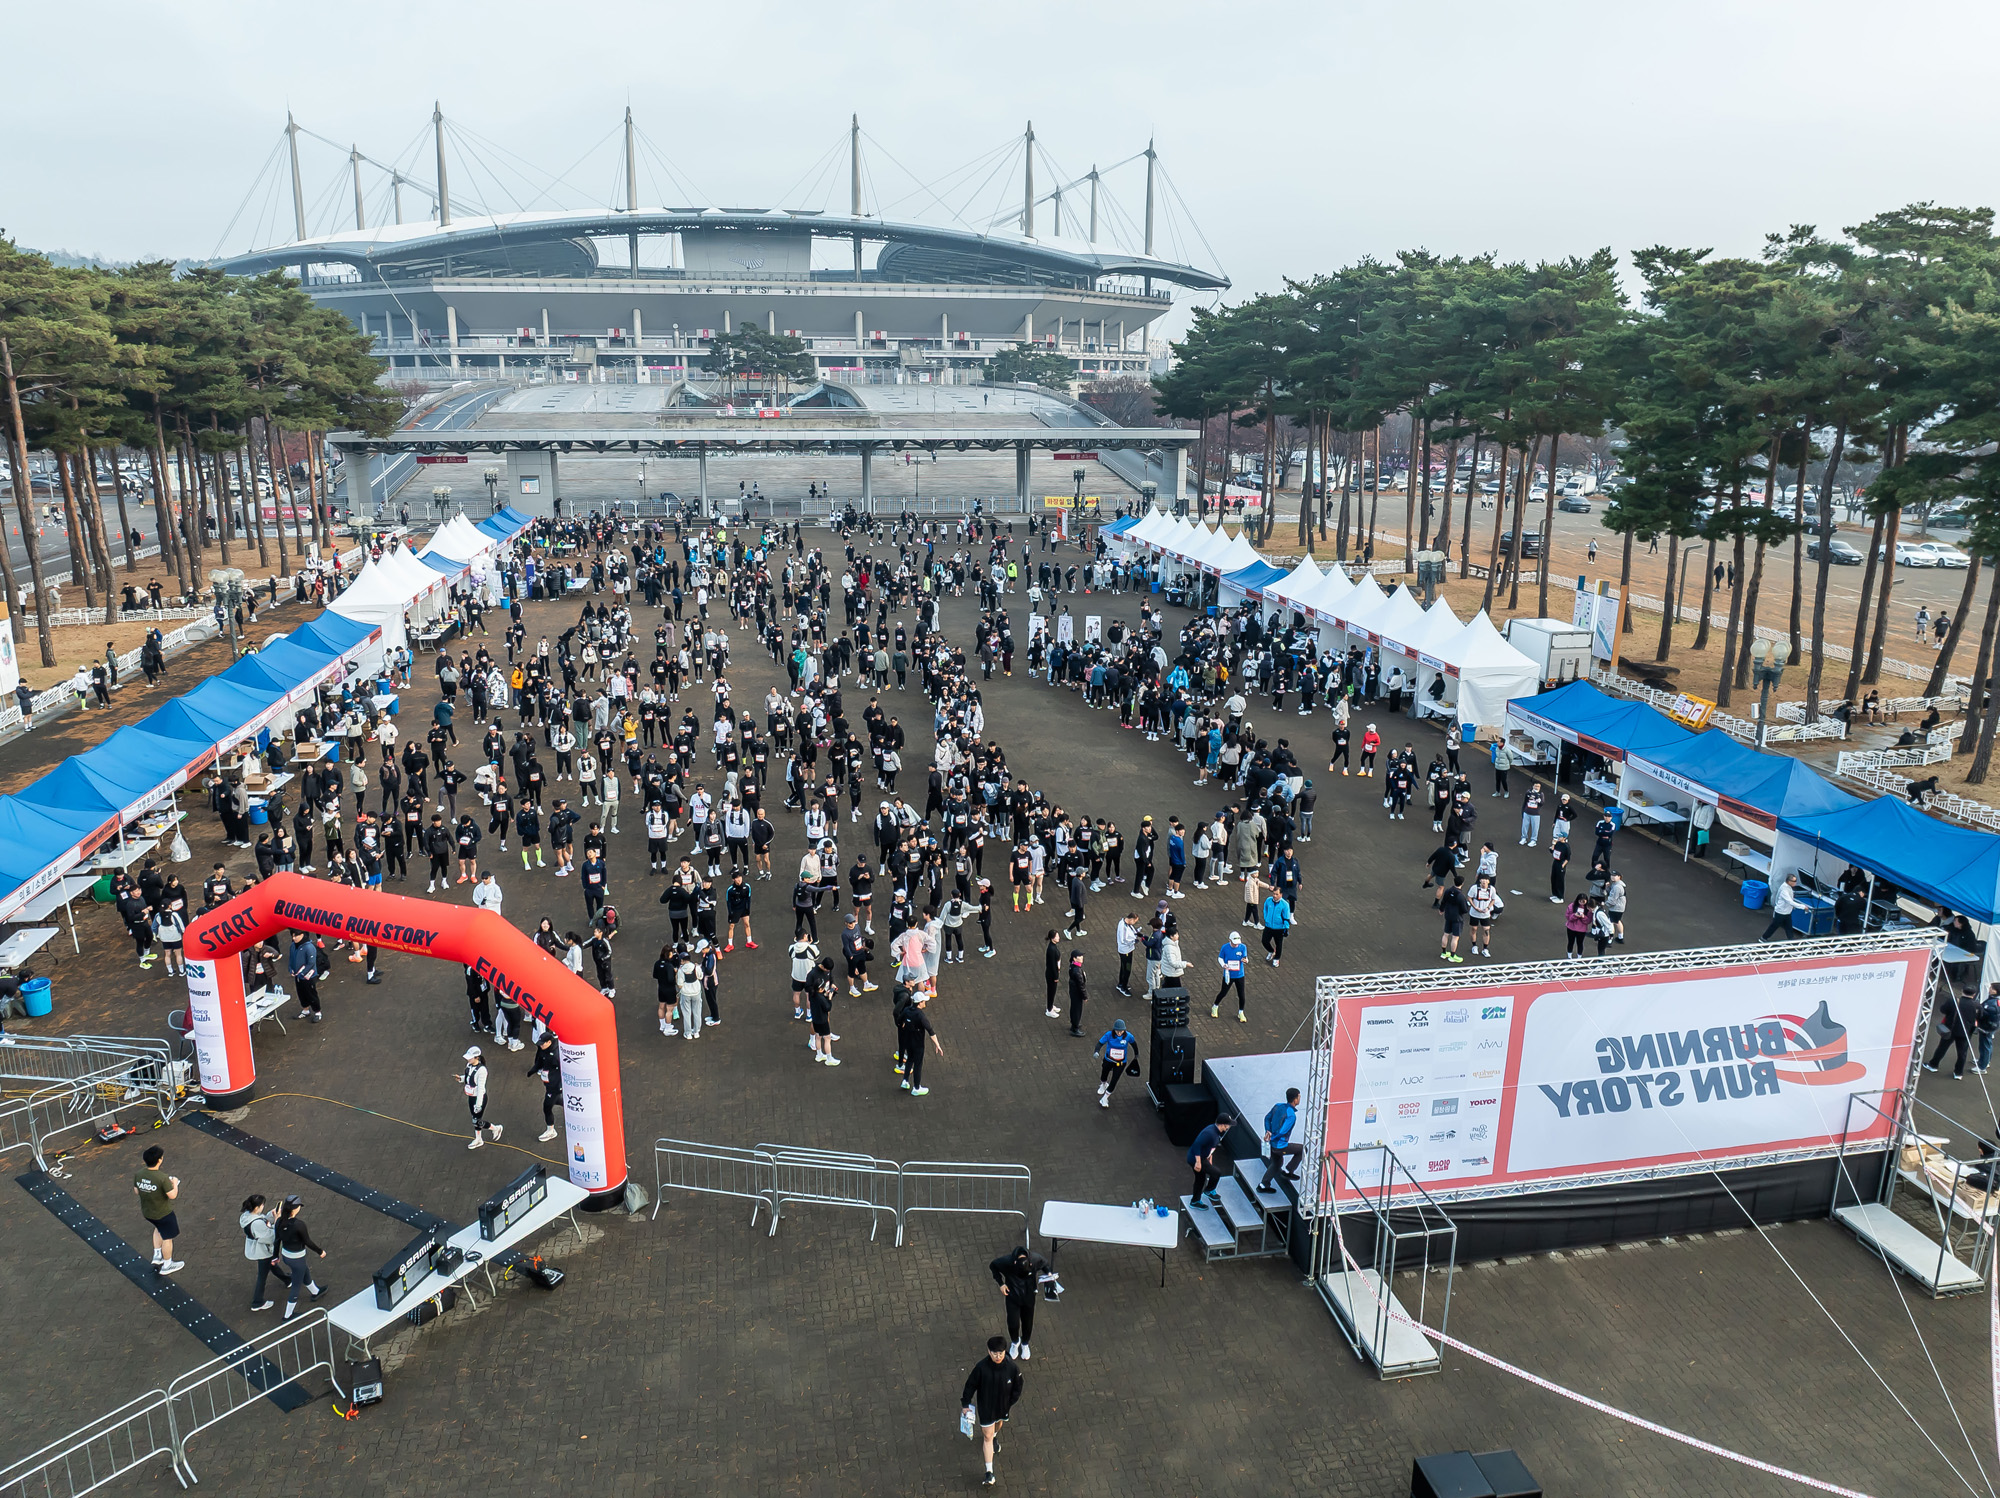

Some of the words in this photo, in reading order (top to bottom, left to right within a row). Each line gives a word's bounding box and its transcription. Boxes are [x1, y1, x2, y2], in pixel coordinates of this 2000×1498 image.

[1046, 498, 1065, 506] 화장실
[1527, 714, 1542, 727] PRESS
[1541, 720, 1557, 733] ROOM
[1652, 767, 1690, 791] 사회자대기실
[199, 906, 261, 953] START
[273, 899, 344, 930] BURNING
[345, 916, 381, 937] RUN
[382, 923, 440, 948] STORY
[349, 932, 375, 944] Casual
[375, 937, 403, 949] Running
[402, 942, 433, 955] Festival
[475, 956, 555, 1026] FINISH
[508, 1176, 537, 1205] SAMIK
[405, 1237, 436, 1268] SAMIK
